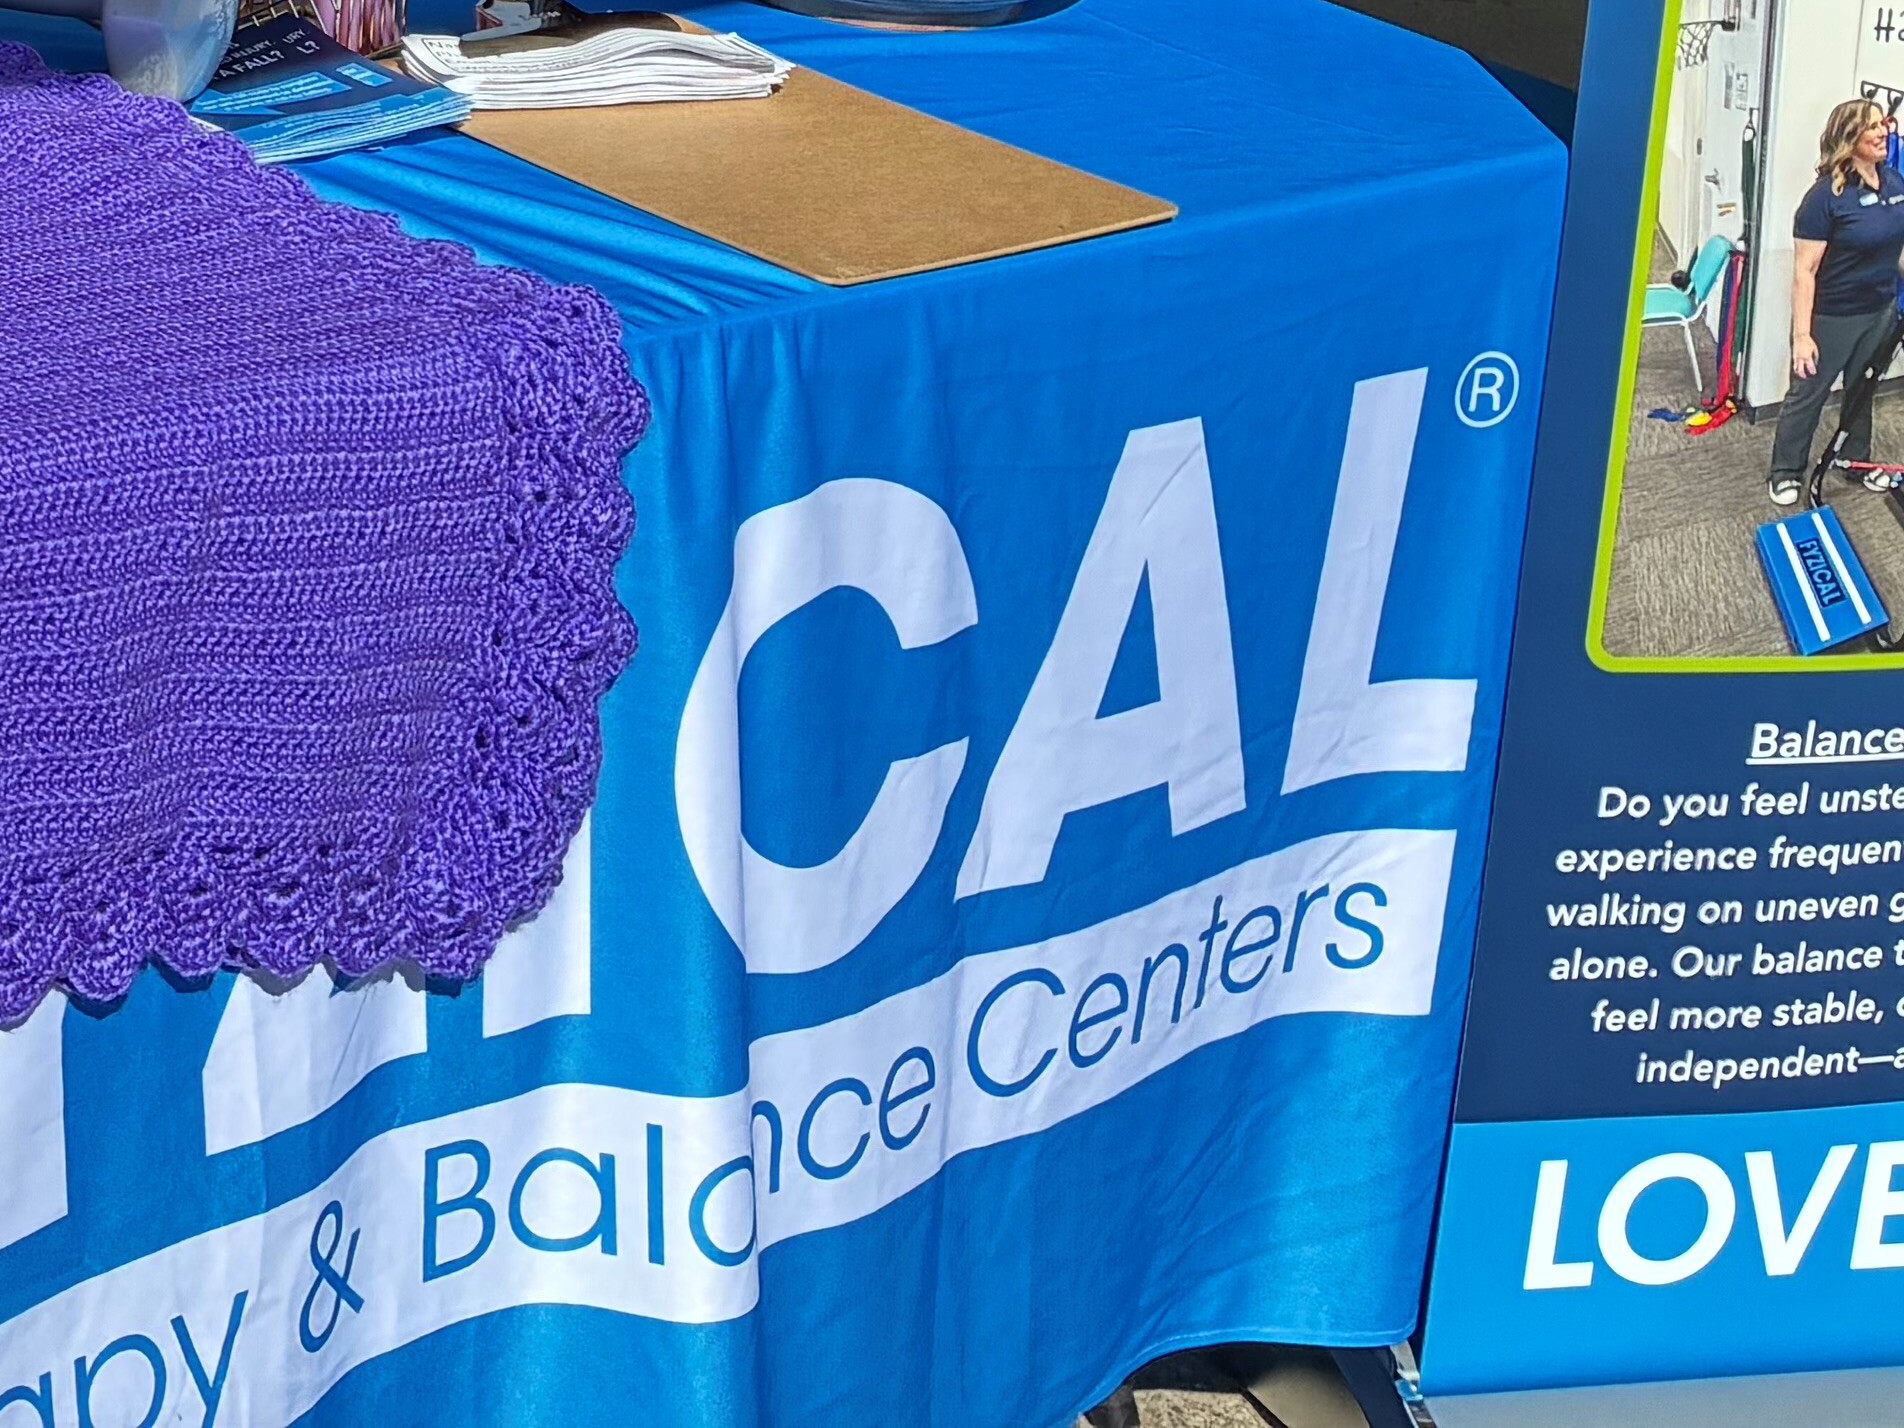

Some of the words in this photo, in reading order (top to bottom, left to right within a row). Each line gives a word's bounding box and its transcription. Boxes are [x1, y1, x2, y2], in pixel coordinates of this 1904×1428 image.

[232, 49, 285, 73] FALL?
[1796, 537, 1843, 608] FYZICAL
[1749, 720, 1904, 760] Balance
[1597, 786, 1651, 819] Do
[1659, 791, 1730, 827] you
[1739, 783, 1810, 817] feel
[1555, 843, 1757, 879] experience
[1545, 894, 1687, 934] walking
[1696, 899, 1743, 925] on
[1754, 893, 1878, 923] uneven
[1548, 950, 1659, 982] alone.
[1671, 946, 1742, 979] Our
[1751, 943, 1882, 976] balance
[1590, 999, 1659, 1034] feel
[1668, 1005, 1763, 1030] more
[1771, 994, 1884, 1032] stable,
[293, 1200, 367, 1354] &
[420, 1043, 935, 1284] Balance
[966, 872, 1388, 1098] Centers
